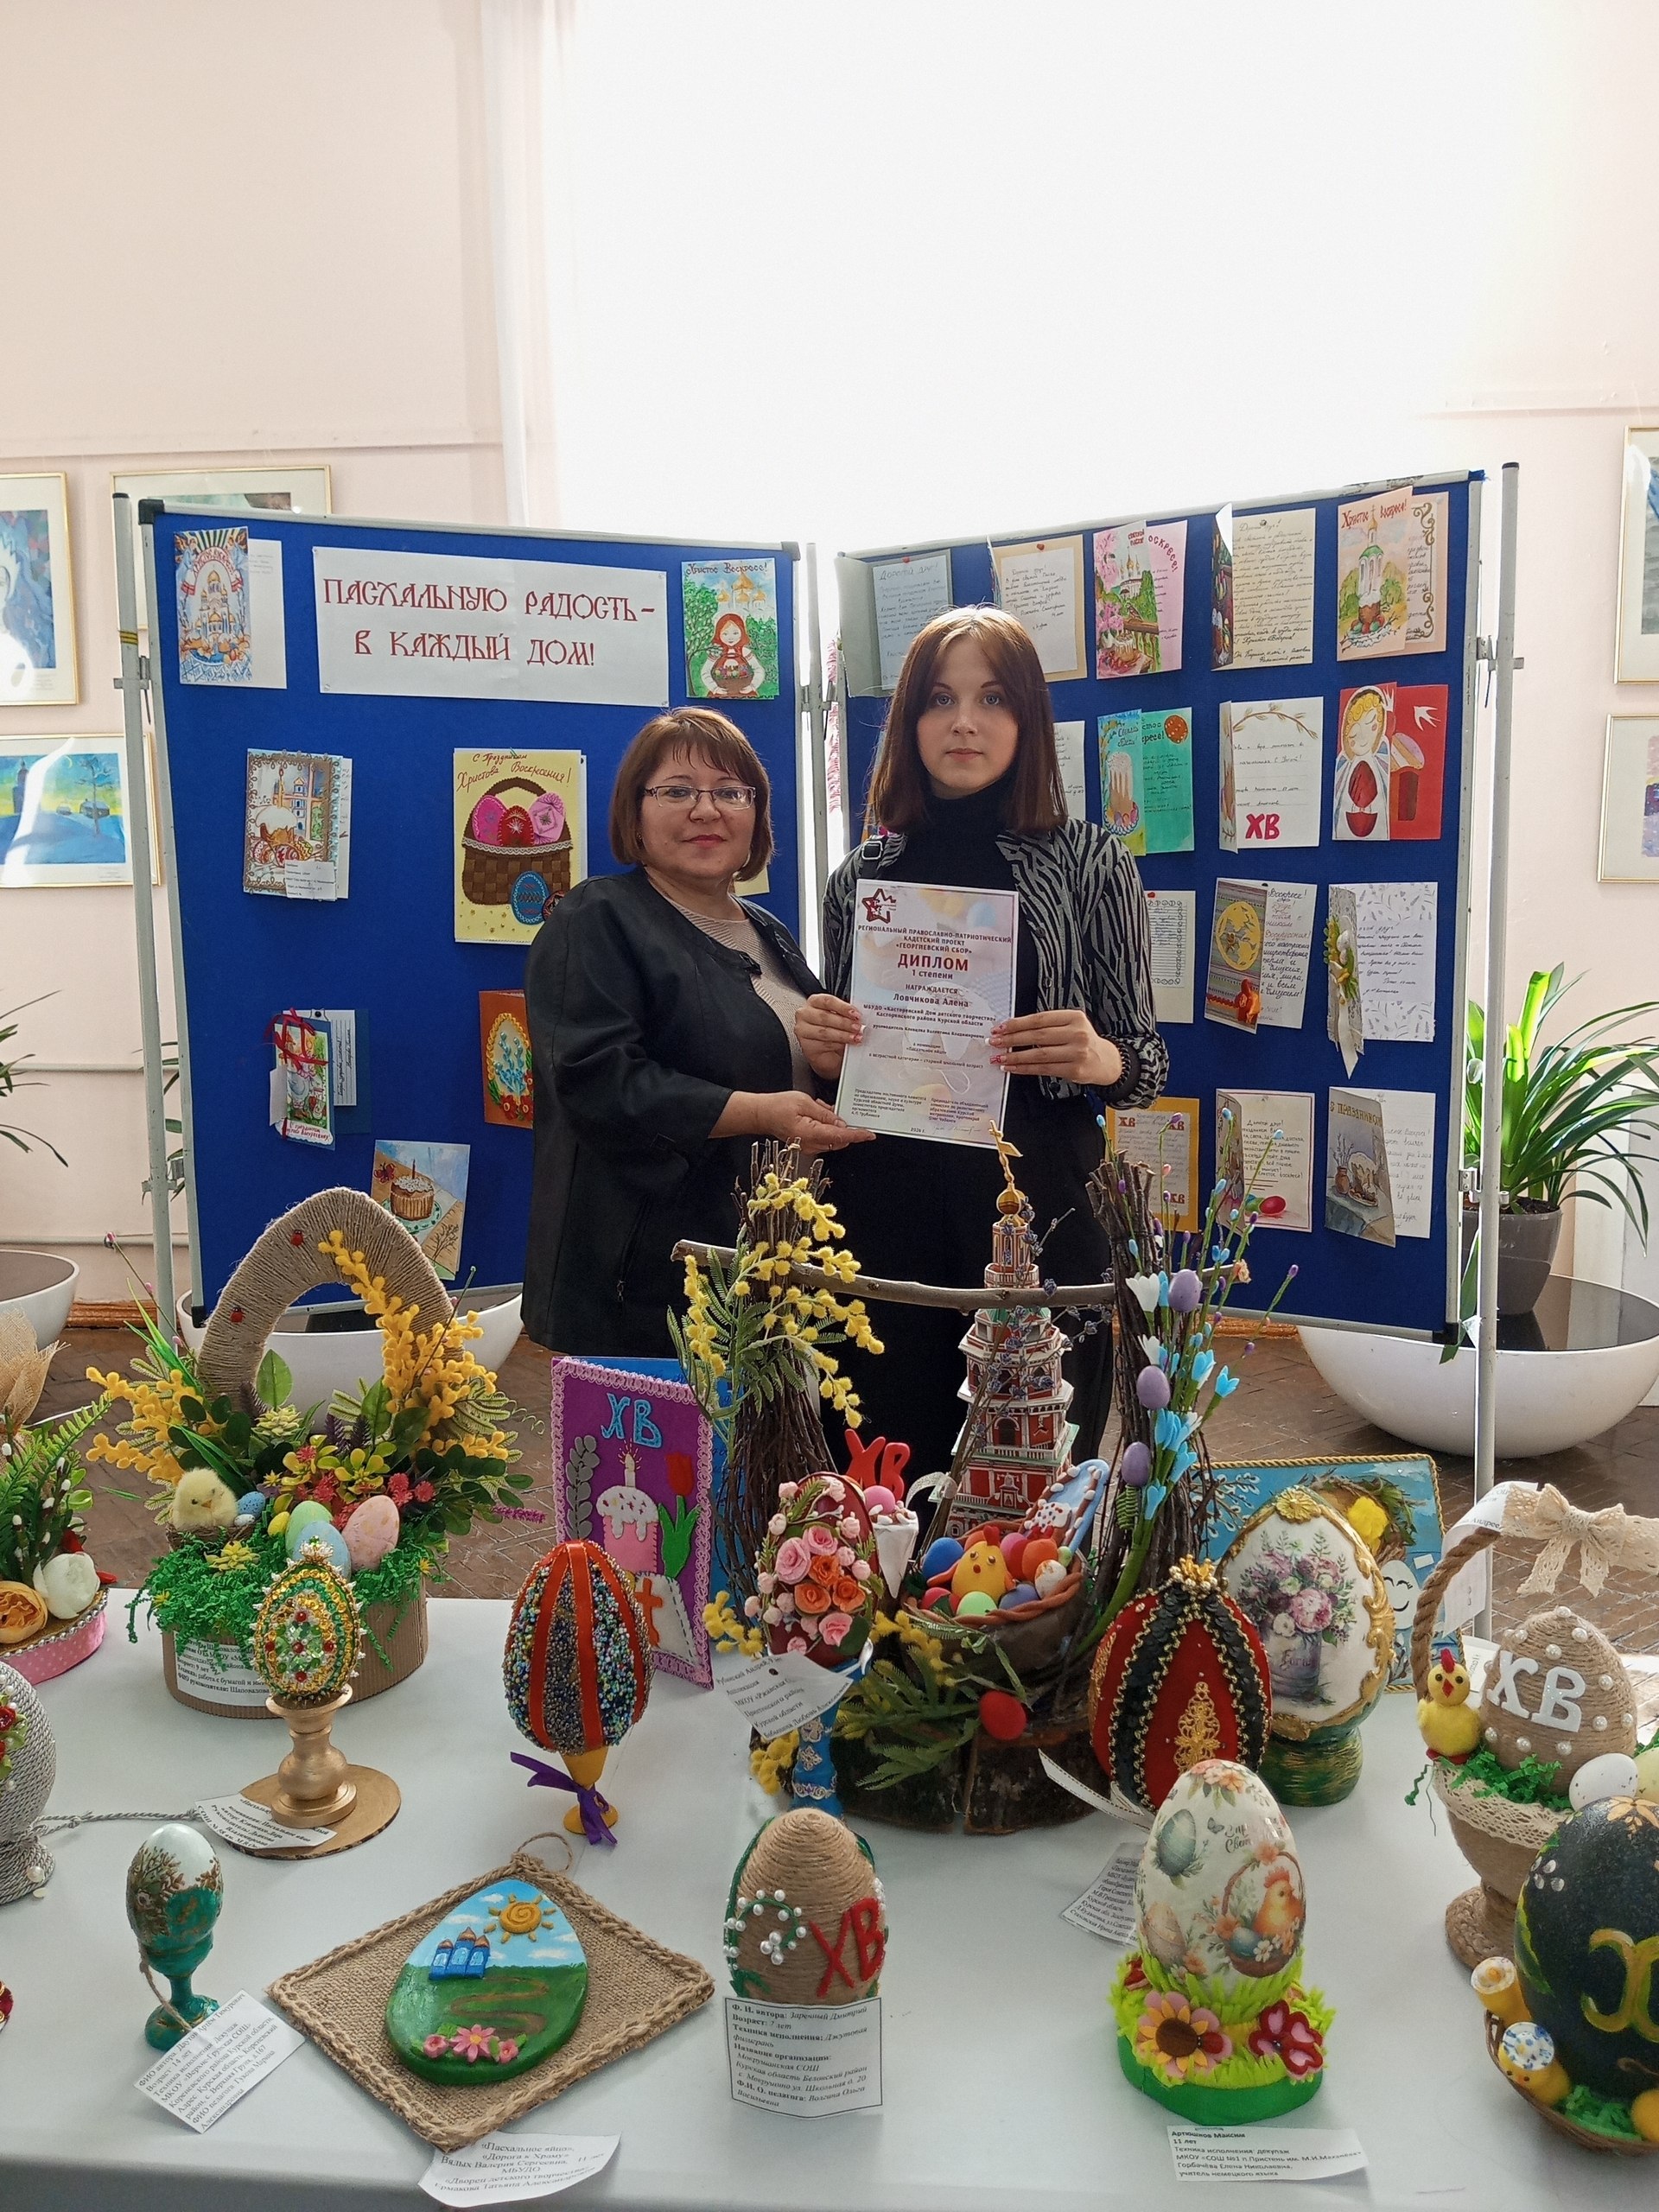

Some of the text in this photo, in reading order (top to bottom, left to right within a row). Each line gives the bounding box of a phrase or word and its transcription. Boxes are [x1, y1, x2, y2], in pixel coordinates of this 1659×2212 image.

[1148, 535, 1179, 572] ОСКРЕСЕ!
[323, 579, 507, 612] ПАСХАЛЬНУЮ
[354, 630, 594, 666] В КАЖДЫЙ ДОМ!
[473, 753, 480, 762] С
[1245, 813, 1281, 839] ХВ
[858, 925, 1012, 943] РЕГИОНАЛЬНЫЙ ПРАВОСЛАВНО-ПАТРИОТИЧЕСКИЙ
[896, 943, 950, 952] «ГЕОРГИЕВСКИЙ
[898, 953, 969, 971] ДИПЛОМ
[906, 984, 958, 995] НАГРАЖДАЕТСЯ
[943, 998, 969, 1007] Алена
[601, 1393, 663, 1448] ХВ
[845, 1428, 911, 1502] ХВ
[1486, 1649, 1586, 1732] ХВ
[808, 1897, 886, 1999] ХВ
[733, 2014, 768, 2027] Возраст:
[755, 2009, 787, 2019] автора:
[791, 2012, 829, 2020] Заречный
[830, 2006, 868, 2021] Дмитрий
[733, 2024, 768, 2037] Техника
[770, 2031, 823, 2041] исполнения:
[734, 2043, 832, 2062] Название организации:
[138, 2070, 156, 2087] ФИО
[156, 2051, 177, 2071] автора:
[735, 2061, 766, 2075] Курская
[767, 2072, 800, 2082] область
[844, 2066, 868, 2078] район
[154, 2073, 180, 2097] Техника
[162, 2082, 183, 2102] МКОУ
[805, 2080, 845, 2092] Школьная
[857, 2075, 867, 2083] 20
[768, 2090, 806, 2101] педагога:
[842, 2086, 866, 2097] Ольга
[192, 2107, 210, 2124] ФИО
[481, 2142, 543, 2152] «Пасхальное
[441, 2156, 473, 2169] Вялых
